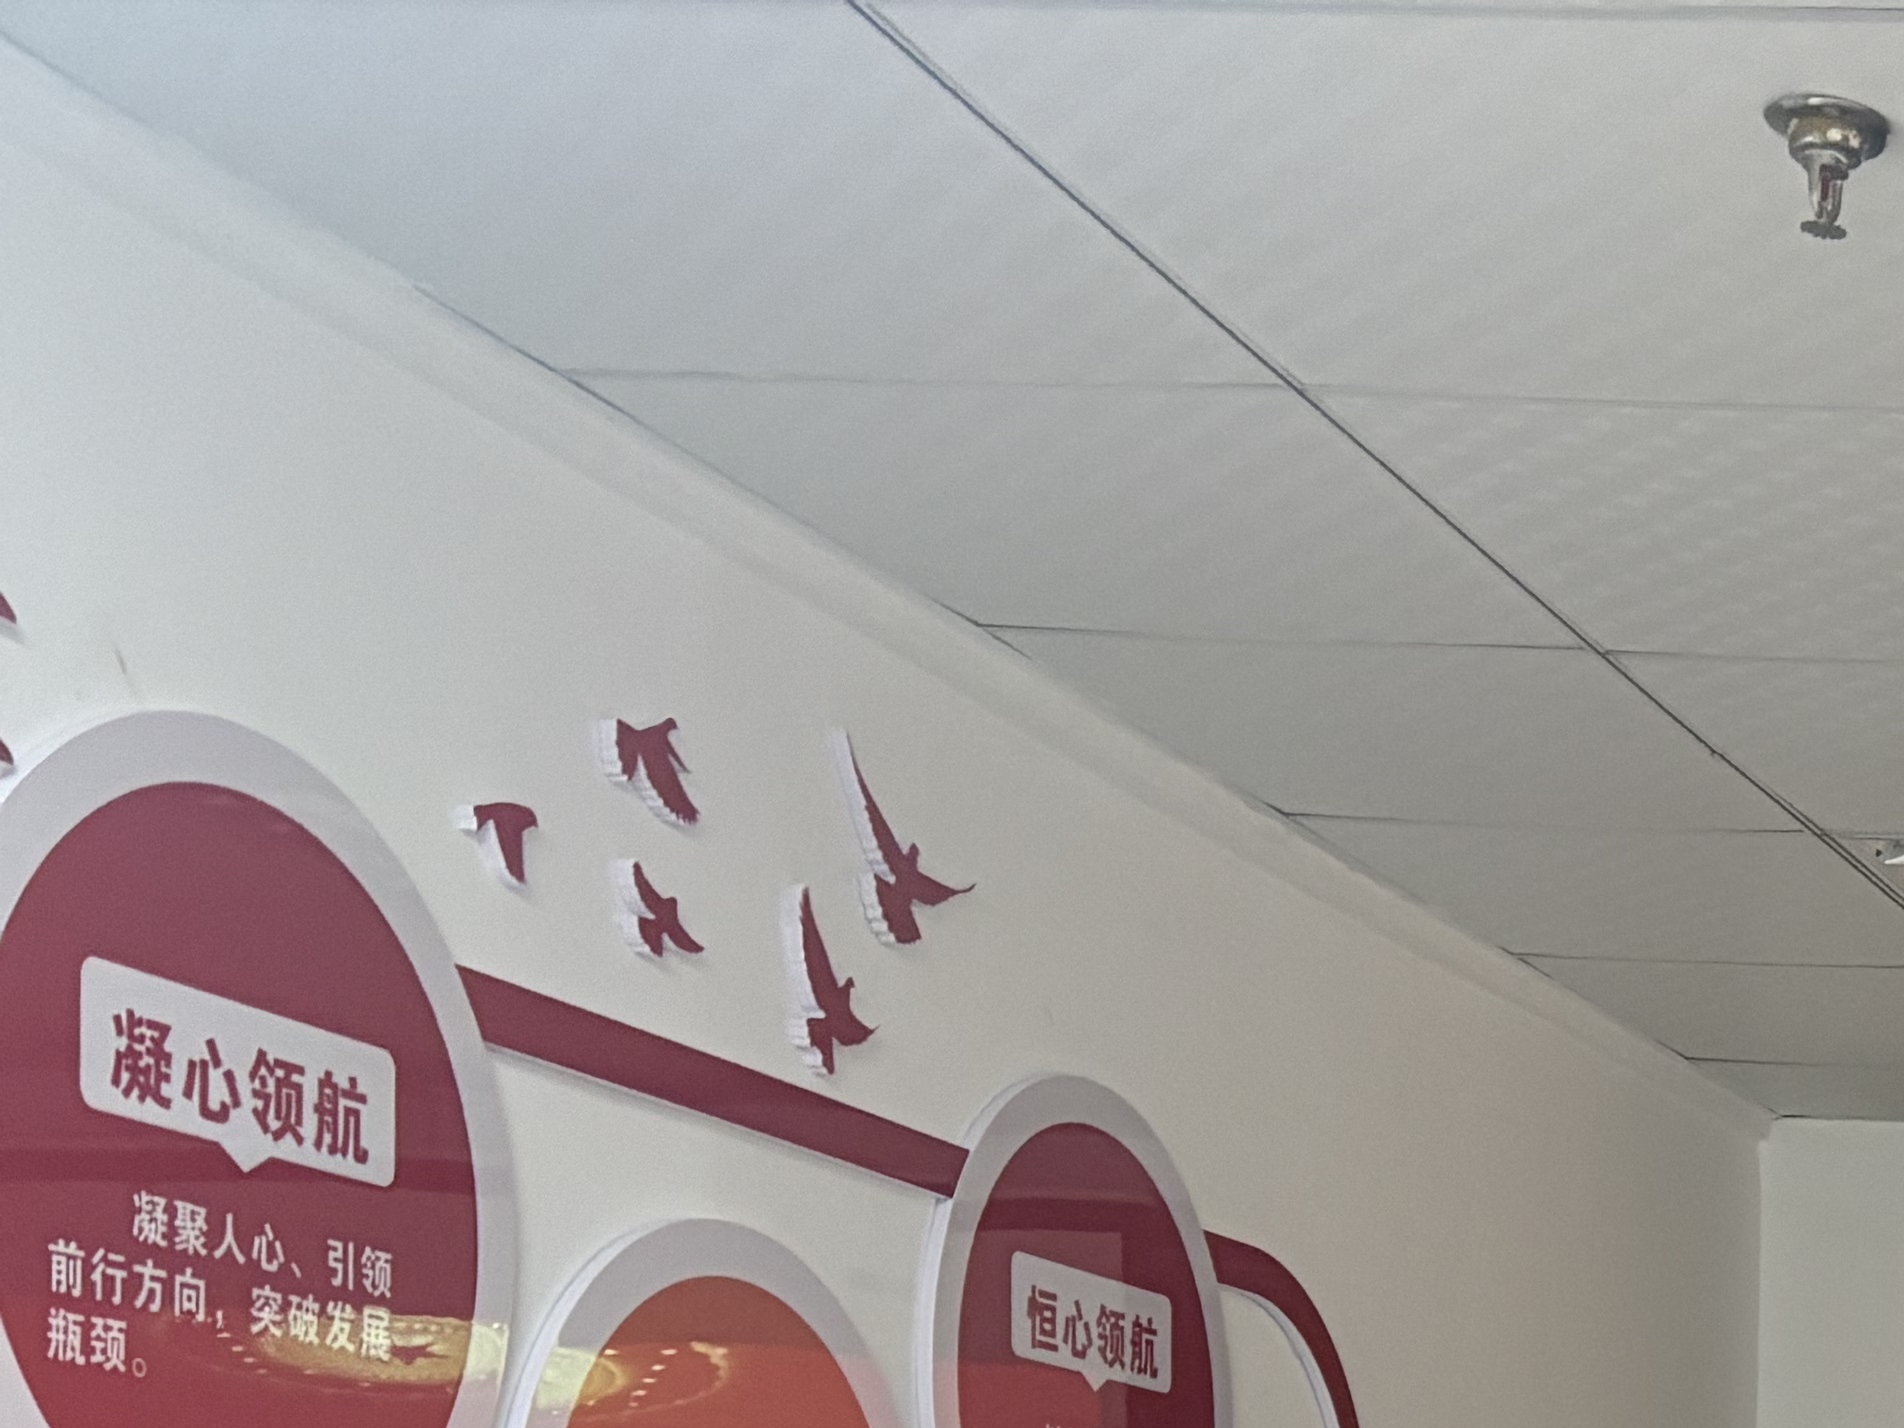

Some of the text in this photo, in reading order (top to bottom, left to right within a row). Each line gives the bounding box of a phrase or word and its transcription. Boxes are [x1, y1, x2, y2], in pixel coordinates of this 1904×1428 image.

[109, 1008, 371, 1165] 凝心领航
[132, 1190, 393, 1299] 凝聚人心、引领
[1026, 1284, 1159, 1379] 恒心领航
